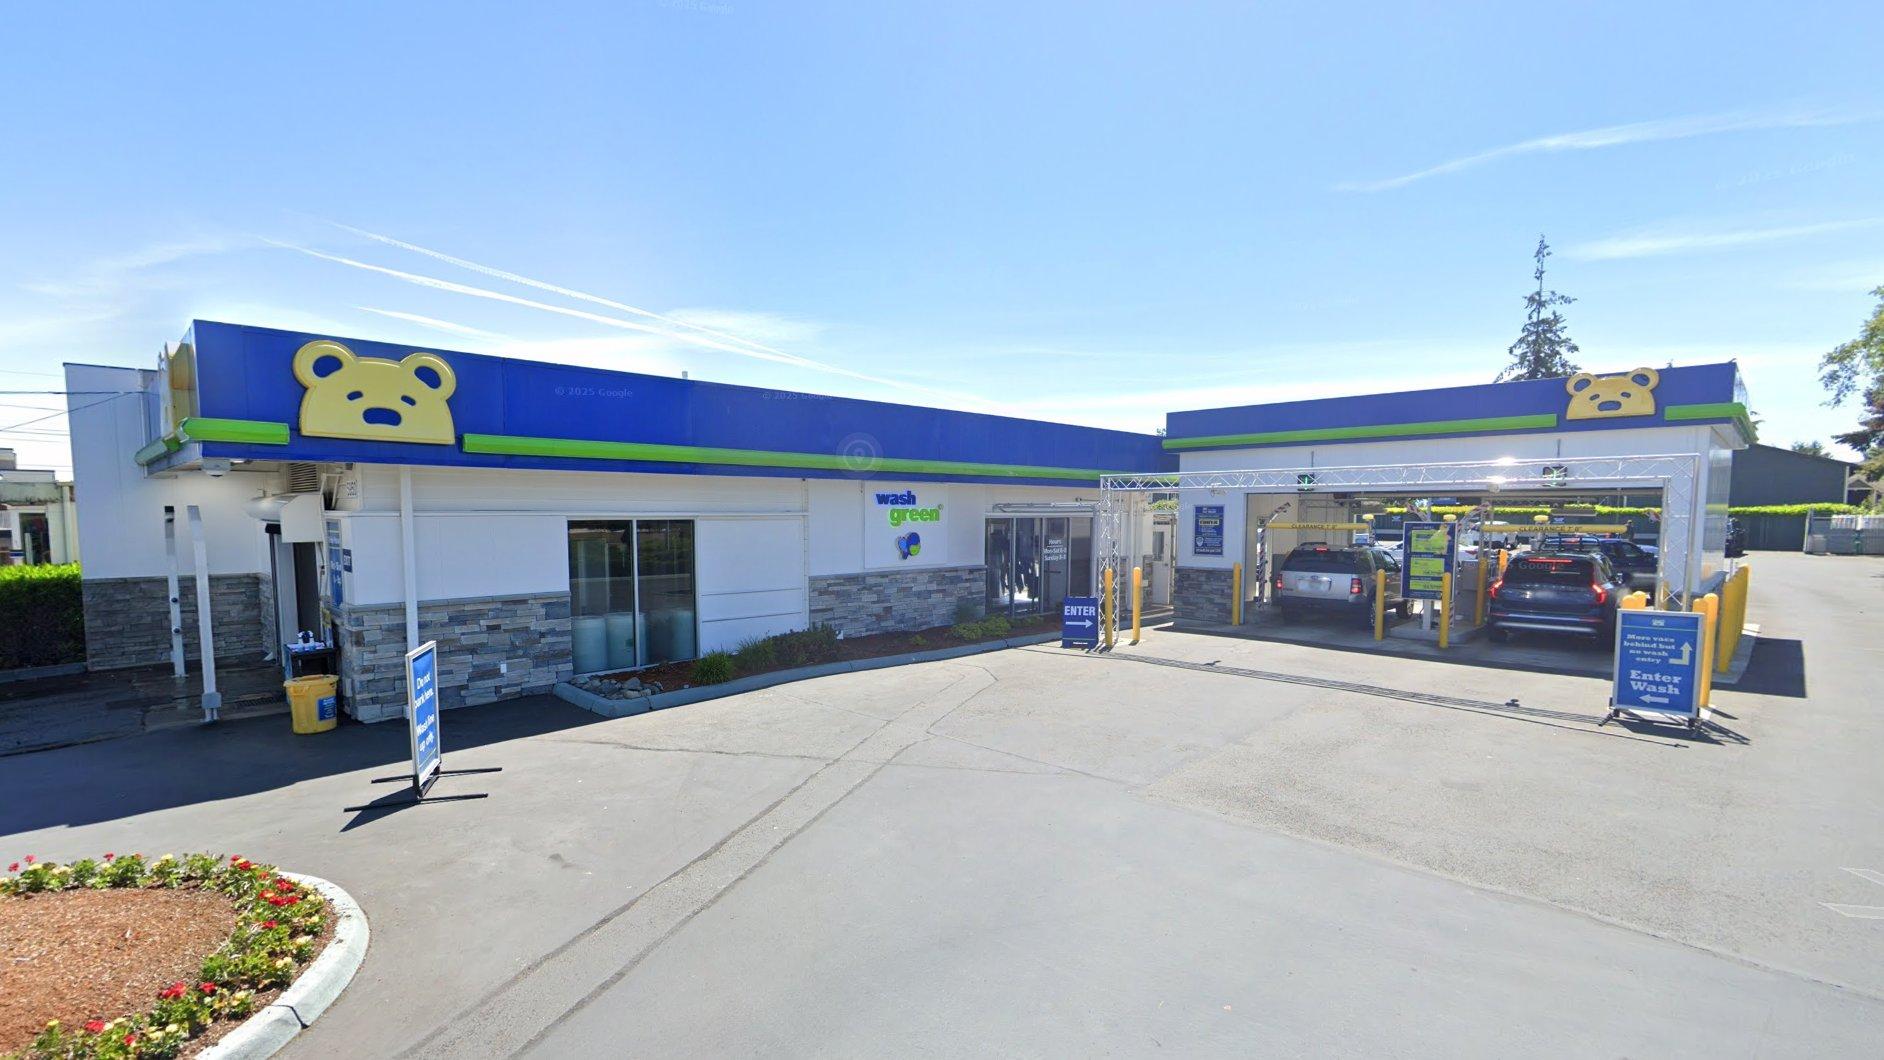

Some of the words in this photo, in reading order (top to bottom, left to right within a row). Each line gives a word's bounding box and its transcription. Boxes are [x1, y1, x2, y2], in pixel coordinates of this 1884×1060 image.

[876, 490, 917, 505] wash
[1064, 605, 1096, 616] ENTER
[1623, 640, 1658, 649] behind
[1629, 669, 1683, 684] Enter
[1629, 681, 1681, 695] Wash
[419, 740, 426, 752] up
